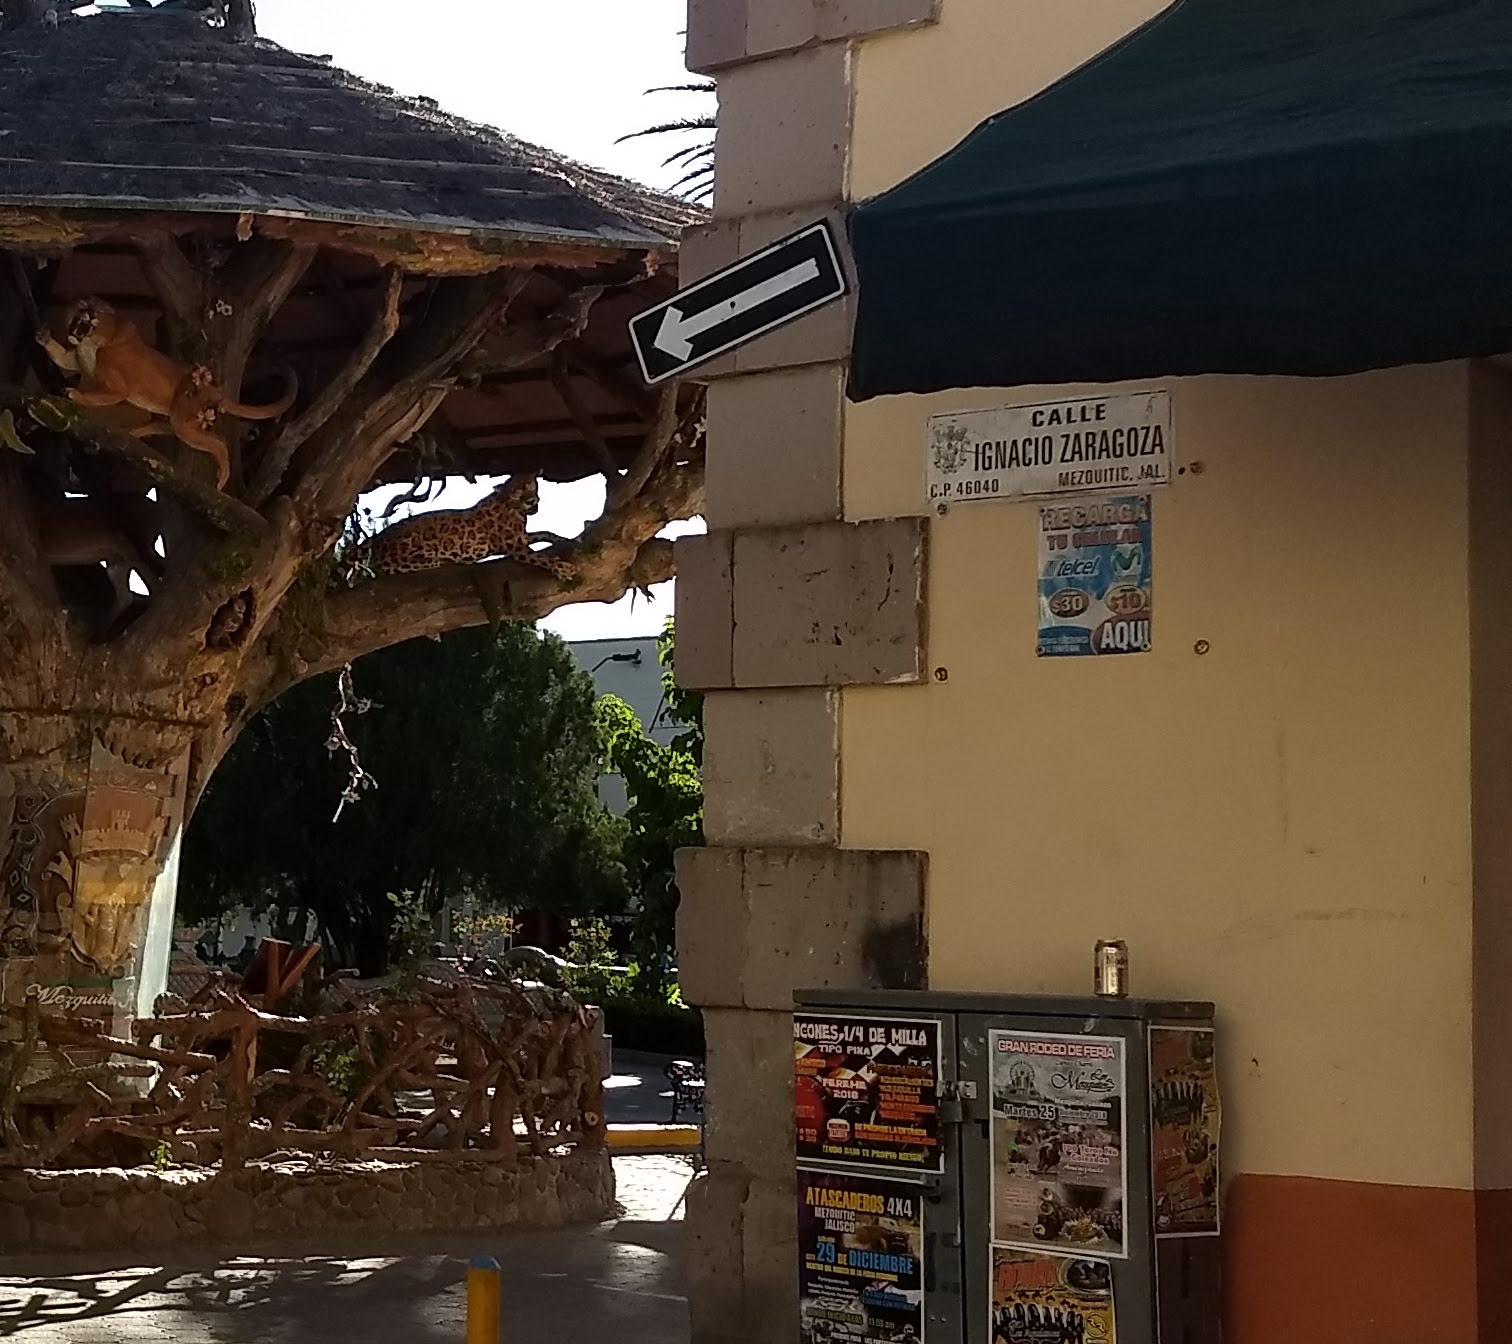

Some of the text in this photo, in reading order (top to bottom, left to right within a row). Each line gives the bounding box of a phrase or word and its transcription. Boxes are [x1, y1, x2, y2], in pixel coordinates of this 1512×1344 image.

[1031, 403, 1106, 427] CALLE
[974, 424, 1165, 472] IGNACIO ZARAGOZA
[956, 478, 1000, 495] 46040
[1041, 503, 1148, 532] RECARGA
[1046, 534, 1069, 550] TU
[1057, 556, 1099, 576] telcel
[1050, 595, 1084, 614] $30
[869, 1027, 887, 1044] DE
[891, 1028, 927, 1046] MILLA
[820, 1044, 843, 1054] TIPO
[998, 1039, 1115, 1059] GRAN RODEO DE FERIA
[833, 1090, 859, 1099] 2018
[1003, 1103, 1038, 1118] Martes
[1039, 1104, 1056, 1120] 25
[805, 1186, 885, 1214] ATASCADEROS
[824, 1218, 855, 1233] JALISCO
[816, 1242, 836, 1263] 29
[837, 1253, 848, 1265] DE
[849, 1250, 914, 1275] DICIEMBRE
